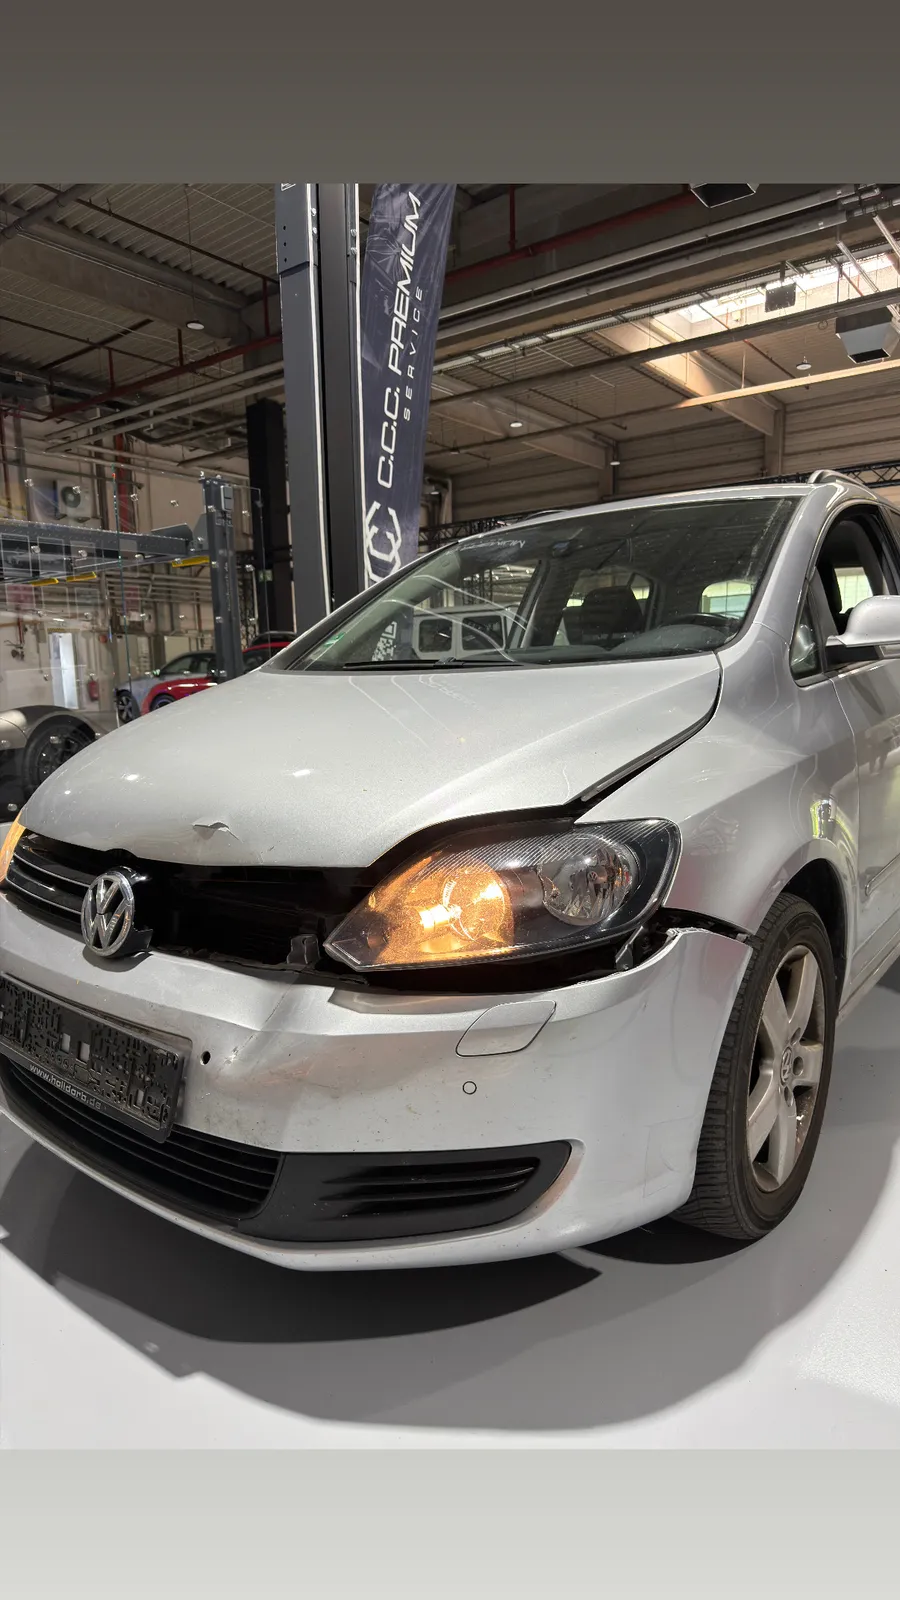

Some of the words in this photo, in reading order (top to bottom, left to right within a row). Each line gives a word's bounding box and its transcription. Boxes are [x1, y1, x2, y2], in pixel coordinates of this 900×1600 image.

[388, 191, 421, 376] PREMIUM
[403, 286, 423, 421] SERVICE
[378, 387, 400, 489] C.C.C.
